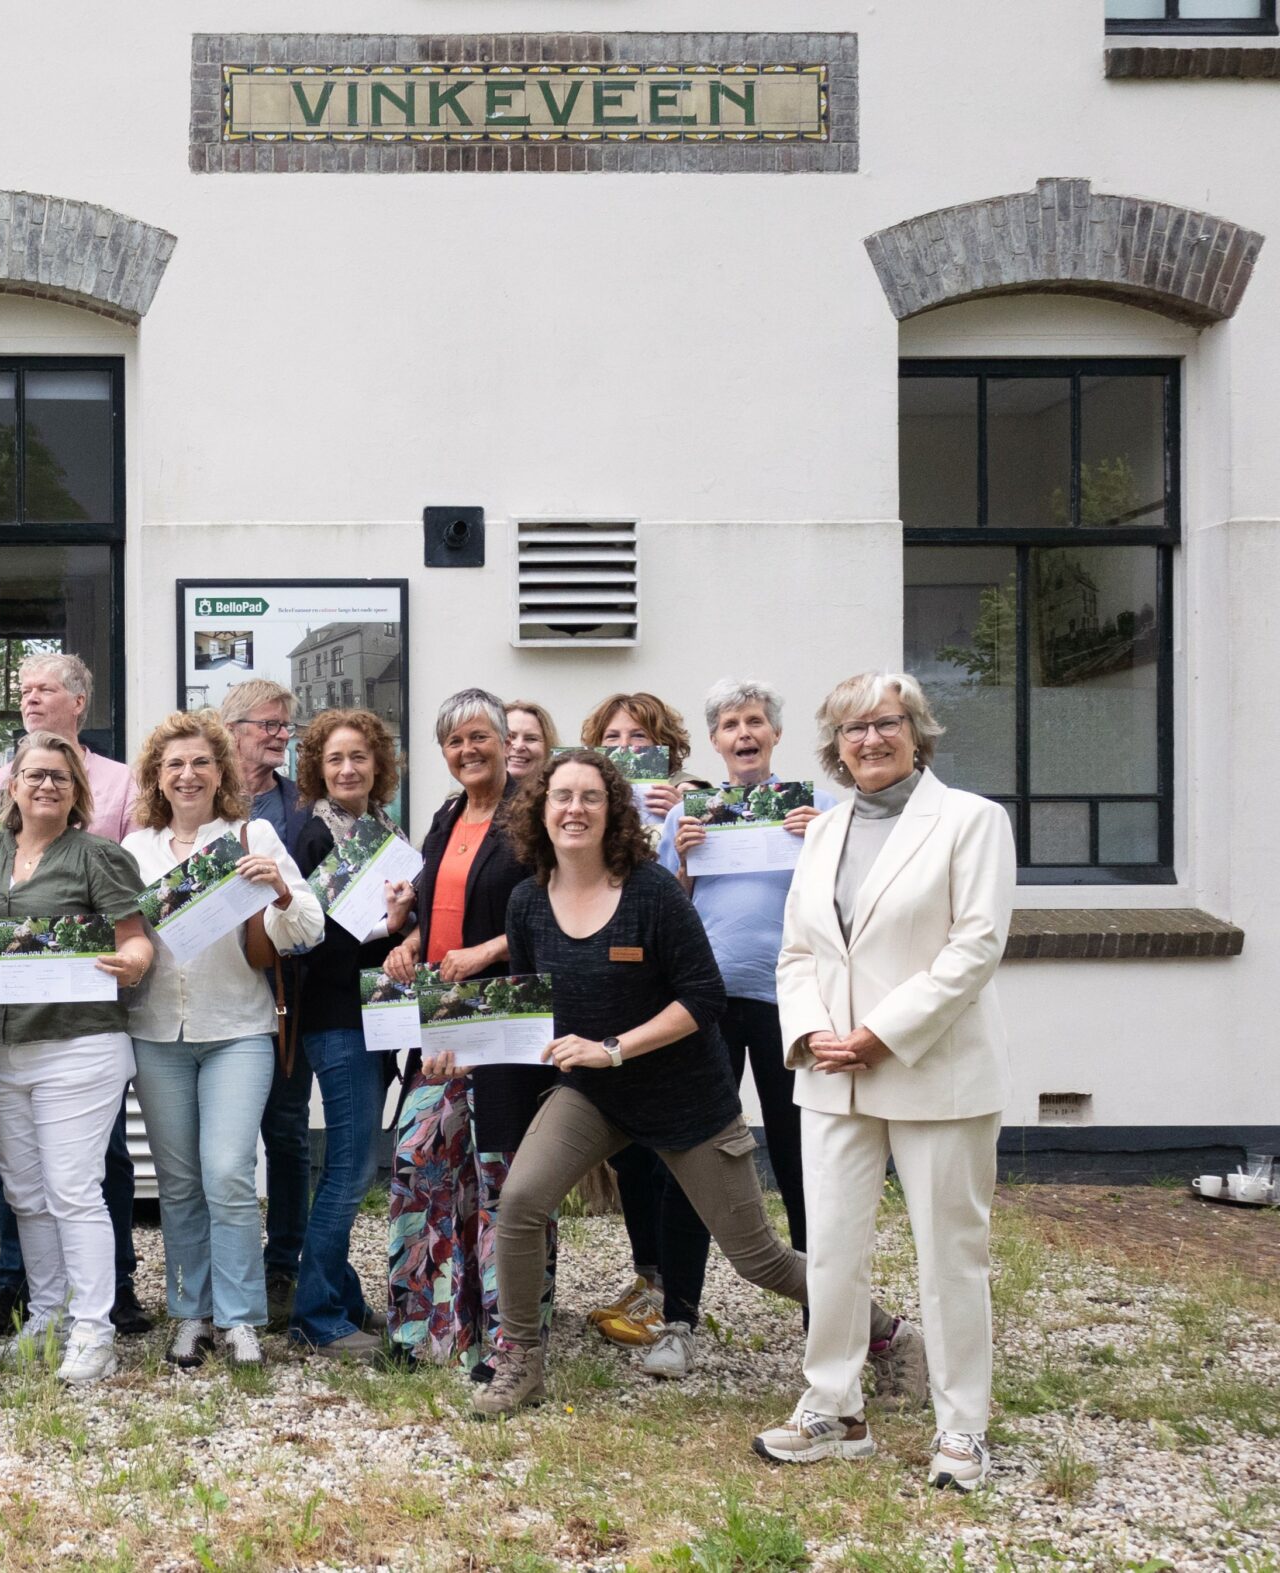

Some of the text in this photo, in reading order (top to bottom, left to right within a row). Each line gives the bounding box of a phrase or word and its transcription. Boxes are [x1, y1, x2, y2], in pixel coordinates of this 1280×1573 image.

[290, 79, 755, 127] VINKEVEEN
[215, 601, 263, 613] BelloPad
[41, 949, 76, 957] Natuurgids
[427, 1017, 457, 1025] Diploma
[471, 1011, 509, 1020] Natuurgids
